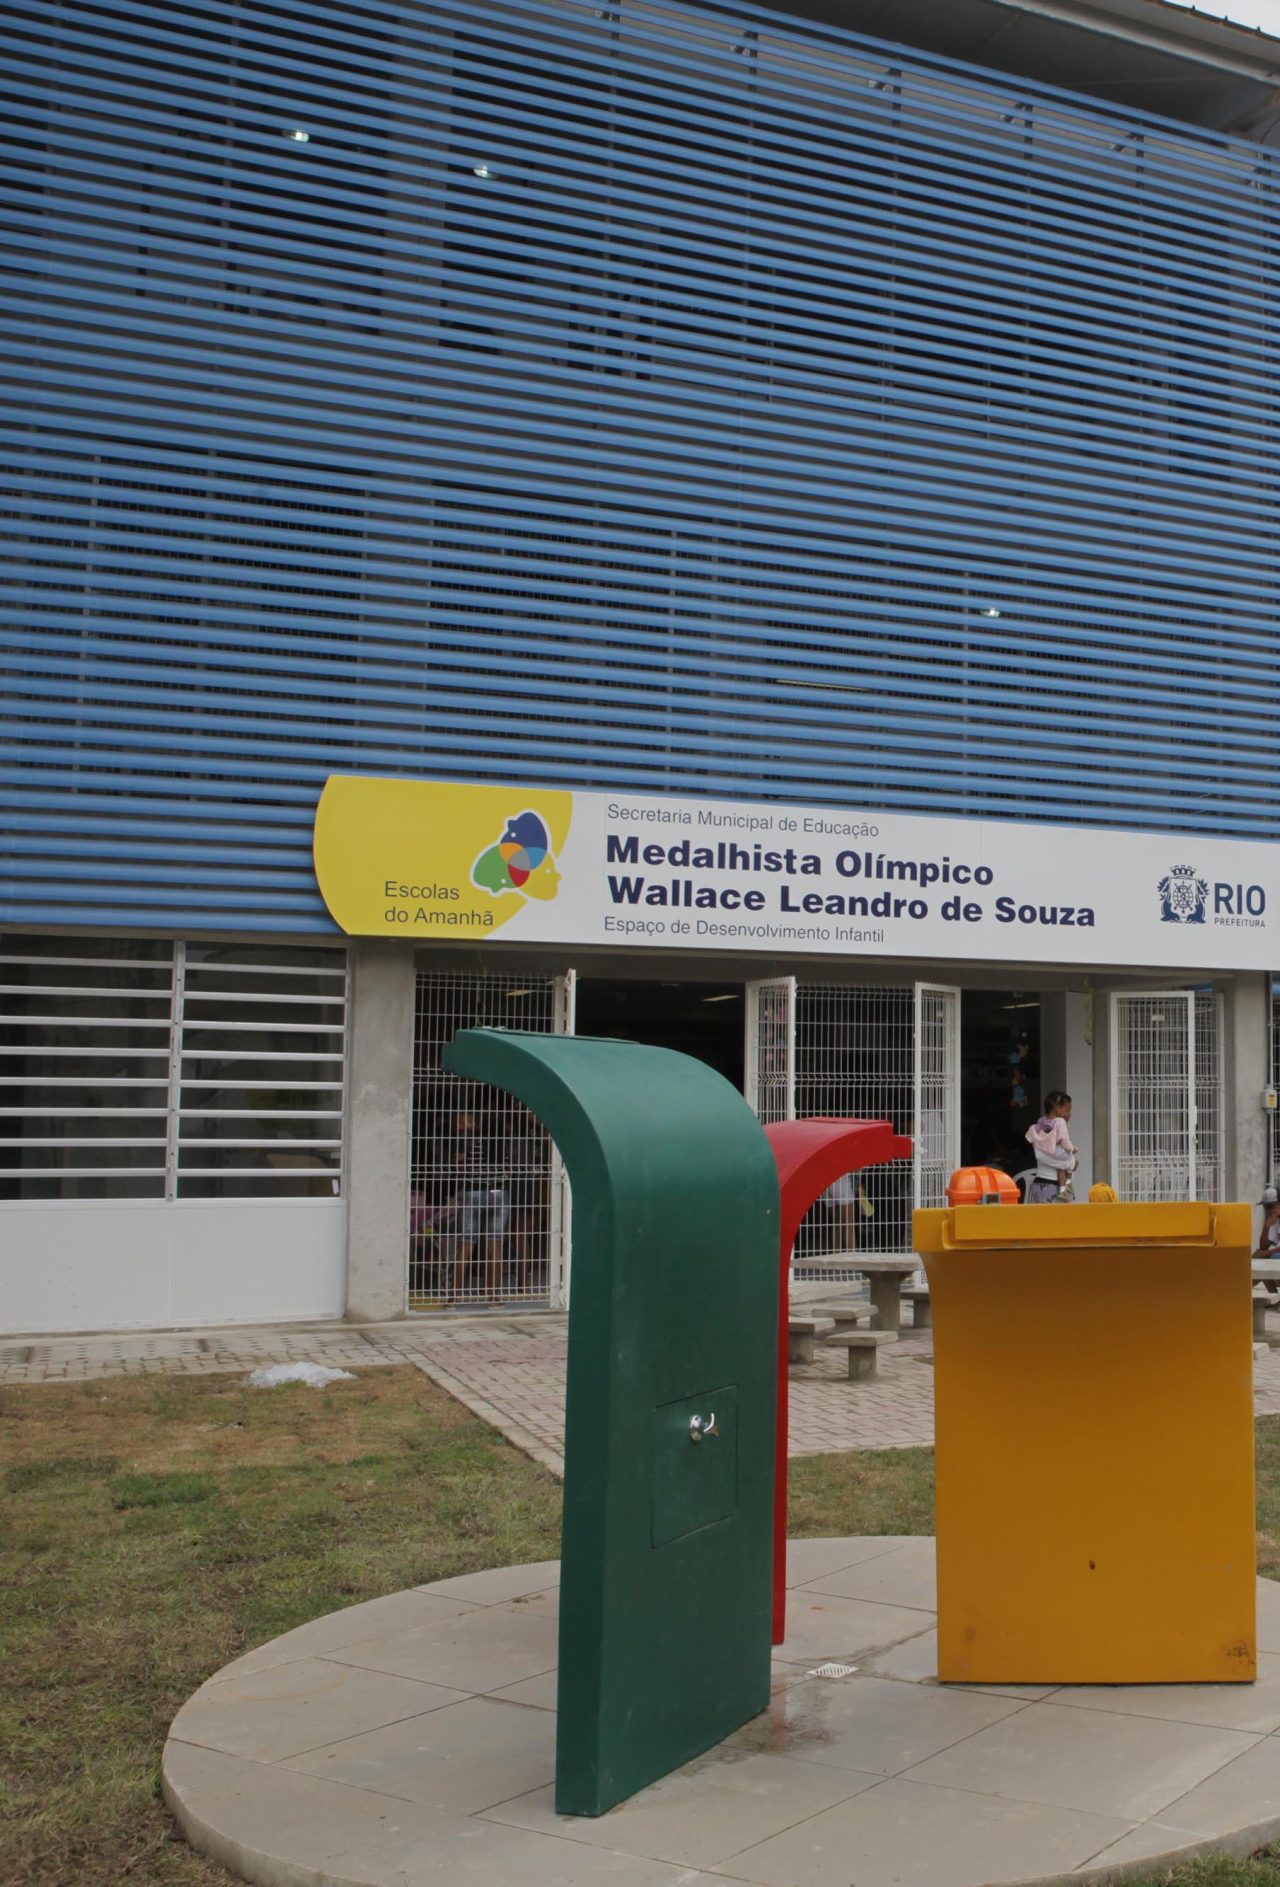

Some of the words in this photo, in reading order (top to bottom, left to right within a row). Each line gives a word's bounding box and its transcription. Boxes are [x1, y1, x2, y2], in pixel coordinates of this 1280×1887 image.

[607, 803, 692, 825] Secretaria
[697, 810, 773, 832] Municipal
[778, 816, 798, 832] de
[803, 817, 879, 840] Educação
[606, 834, 822, 876] Medalhista
[835, 849, 994, 889] Olímpico
[384, 880, 460, 901] Escolas
[606, 874, 766, 912] Wallace
[779, 884, 929, 920] Leandro
[940, 895, 984, 923] de
[994, 896, 1096, 928] Souza
[1213, 882, 1266, 917] RIO
[384, 905, 409, 923] do
[413, 906, 494, 926] Amanhã
[604, 915, 666, 937] Espaço
[670, 919, 691, 935] de
[696, 919, 831, 941] Desenvolvimento
[835, 926, 884, 943] Infantil
[1214, 916, 1266, 928] PREFEITURA
